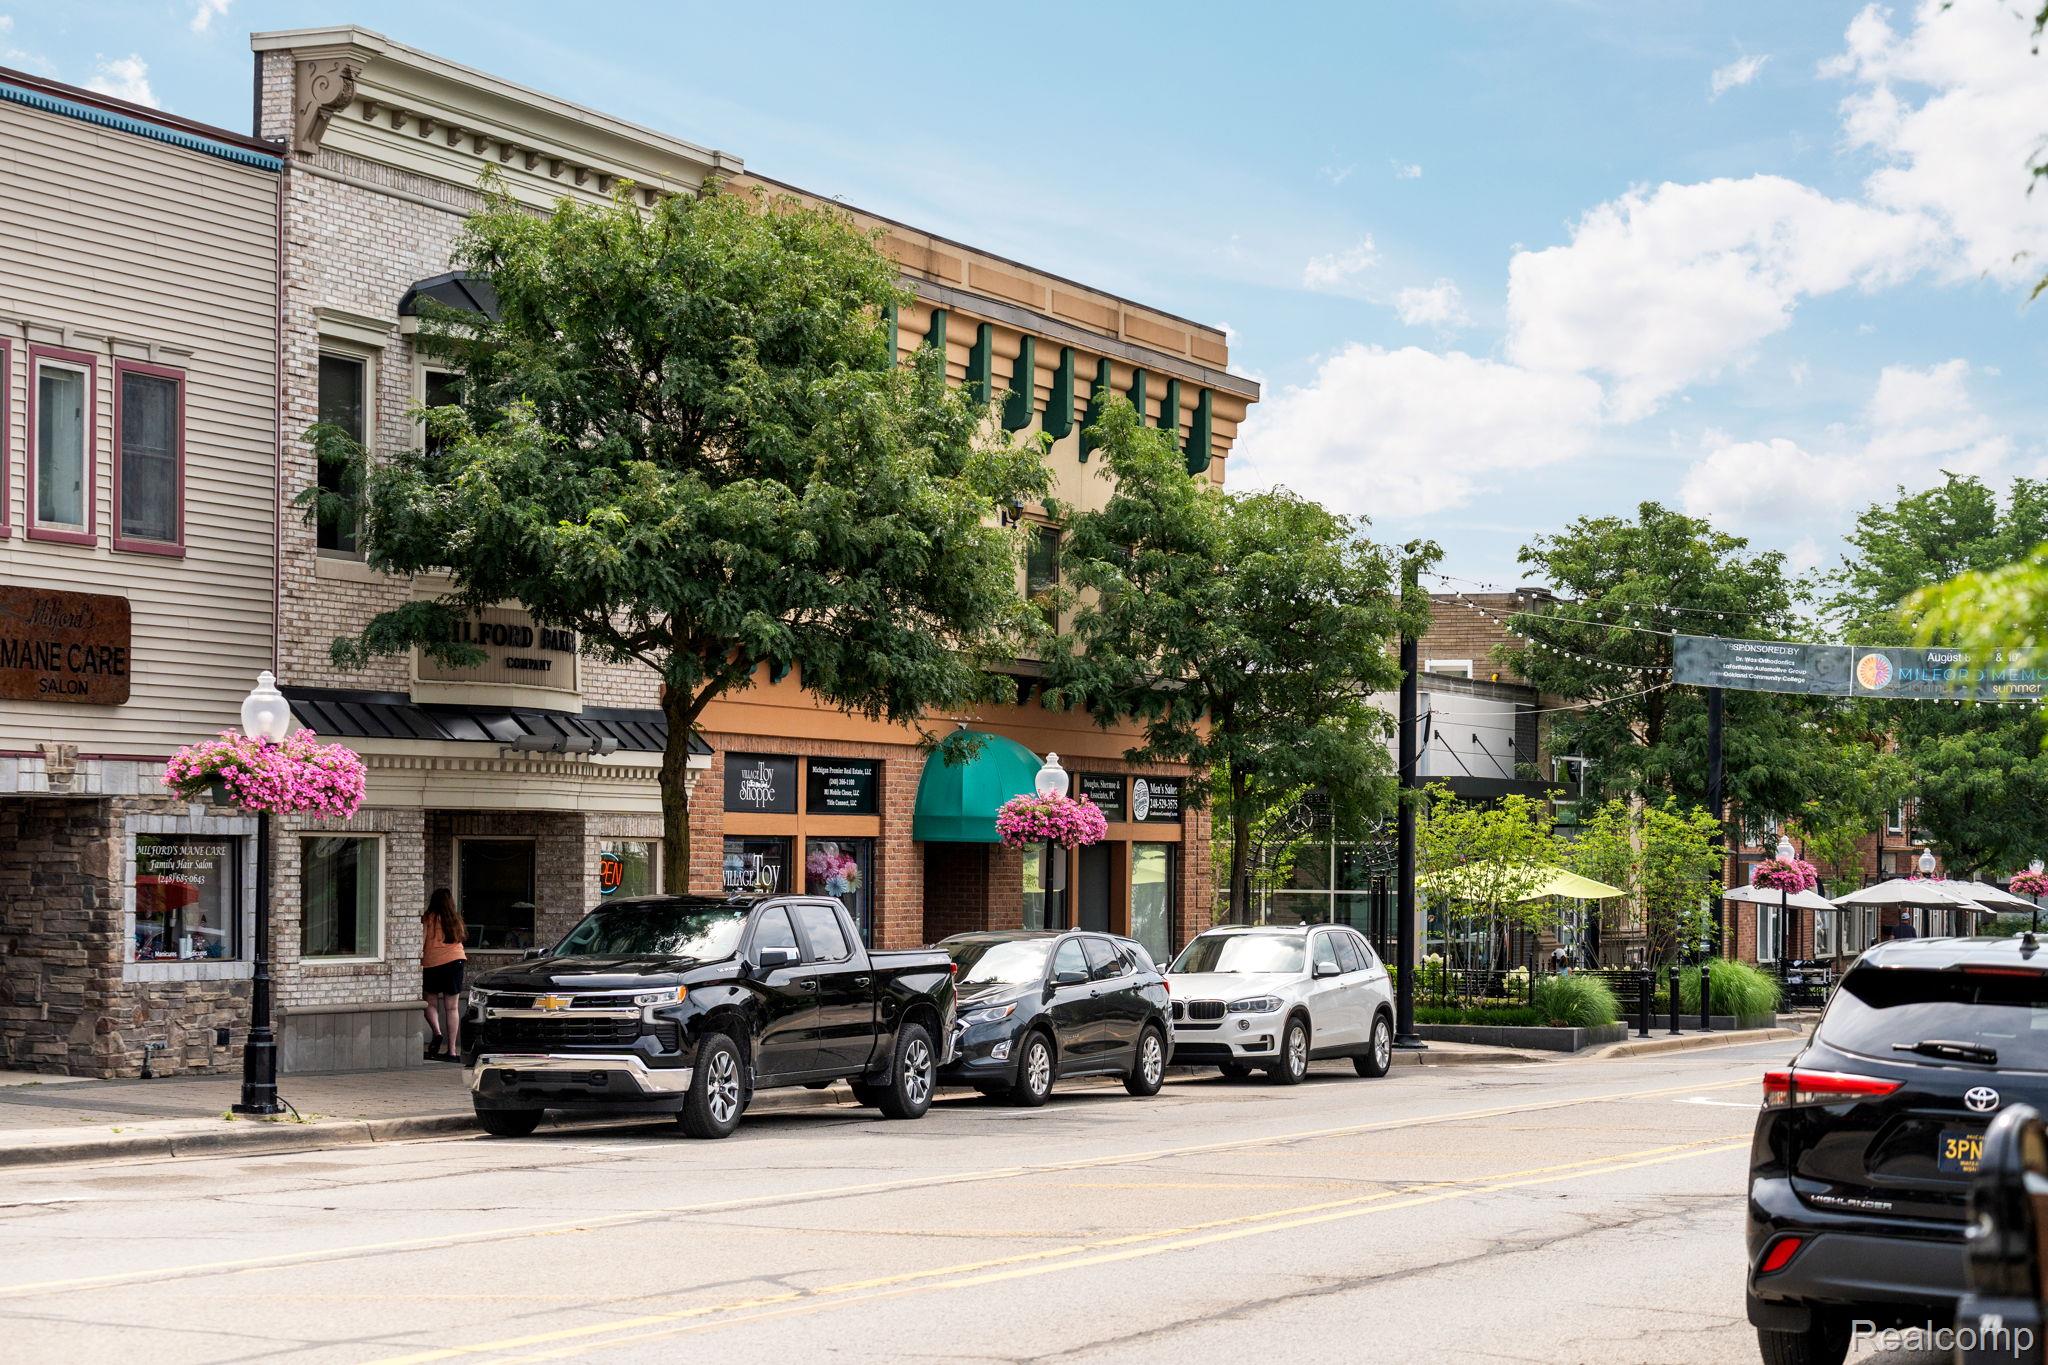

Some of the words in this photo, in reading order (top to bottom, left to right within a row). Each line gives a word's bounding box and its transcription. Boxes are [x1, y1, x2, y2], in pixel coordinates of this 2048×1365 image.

[450, 621, 534, 648] ILFORD
[0, 638, 62, 672] MANE
[67, 643, 126, 676] CARE
[1732, 643, 1787, 654] SPONSORED
[1787, 647, 1800, 656] BY
[506, 656, 553, 671] COMPANY
[1927, 652, 1962, 665] August
[1749, 674, 1782, 682] Community
[1782, 676, 1806, 684] College
[1788, 668, 1807, 676] Group
[39, 678, 89, 695] SALON
[1992, 684, 2042, 694] summer
[757, 761, 774, 788] Toy
[739, 780, 776, 808] Shoppe
[1150, 783, 1165, 794] Men's
[136, 844, 178, 857] MILFORD'S
[180, 846, 204, 856] MANE
[205, 846, 226, 856] CARE
[149, 858, 175, 871] Family
[176, 859, 194, 870] Hair
[195, 858, 213, 869] Salon
[600, 860, 623, 887] PEN
[752, 852, 781, 894] Toy
[1945, 1138, 1983, 1160] 3PN
[1810, 1194, 1893, 1210] HIGHLANDER
